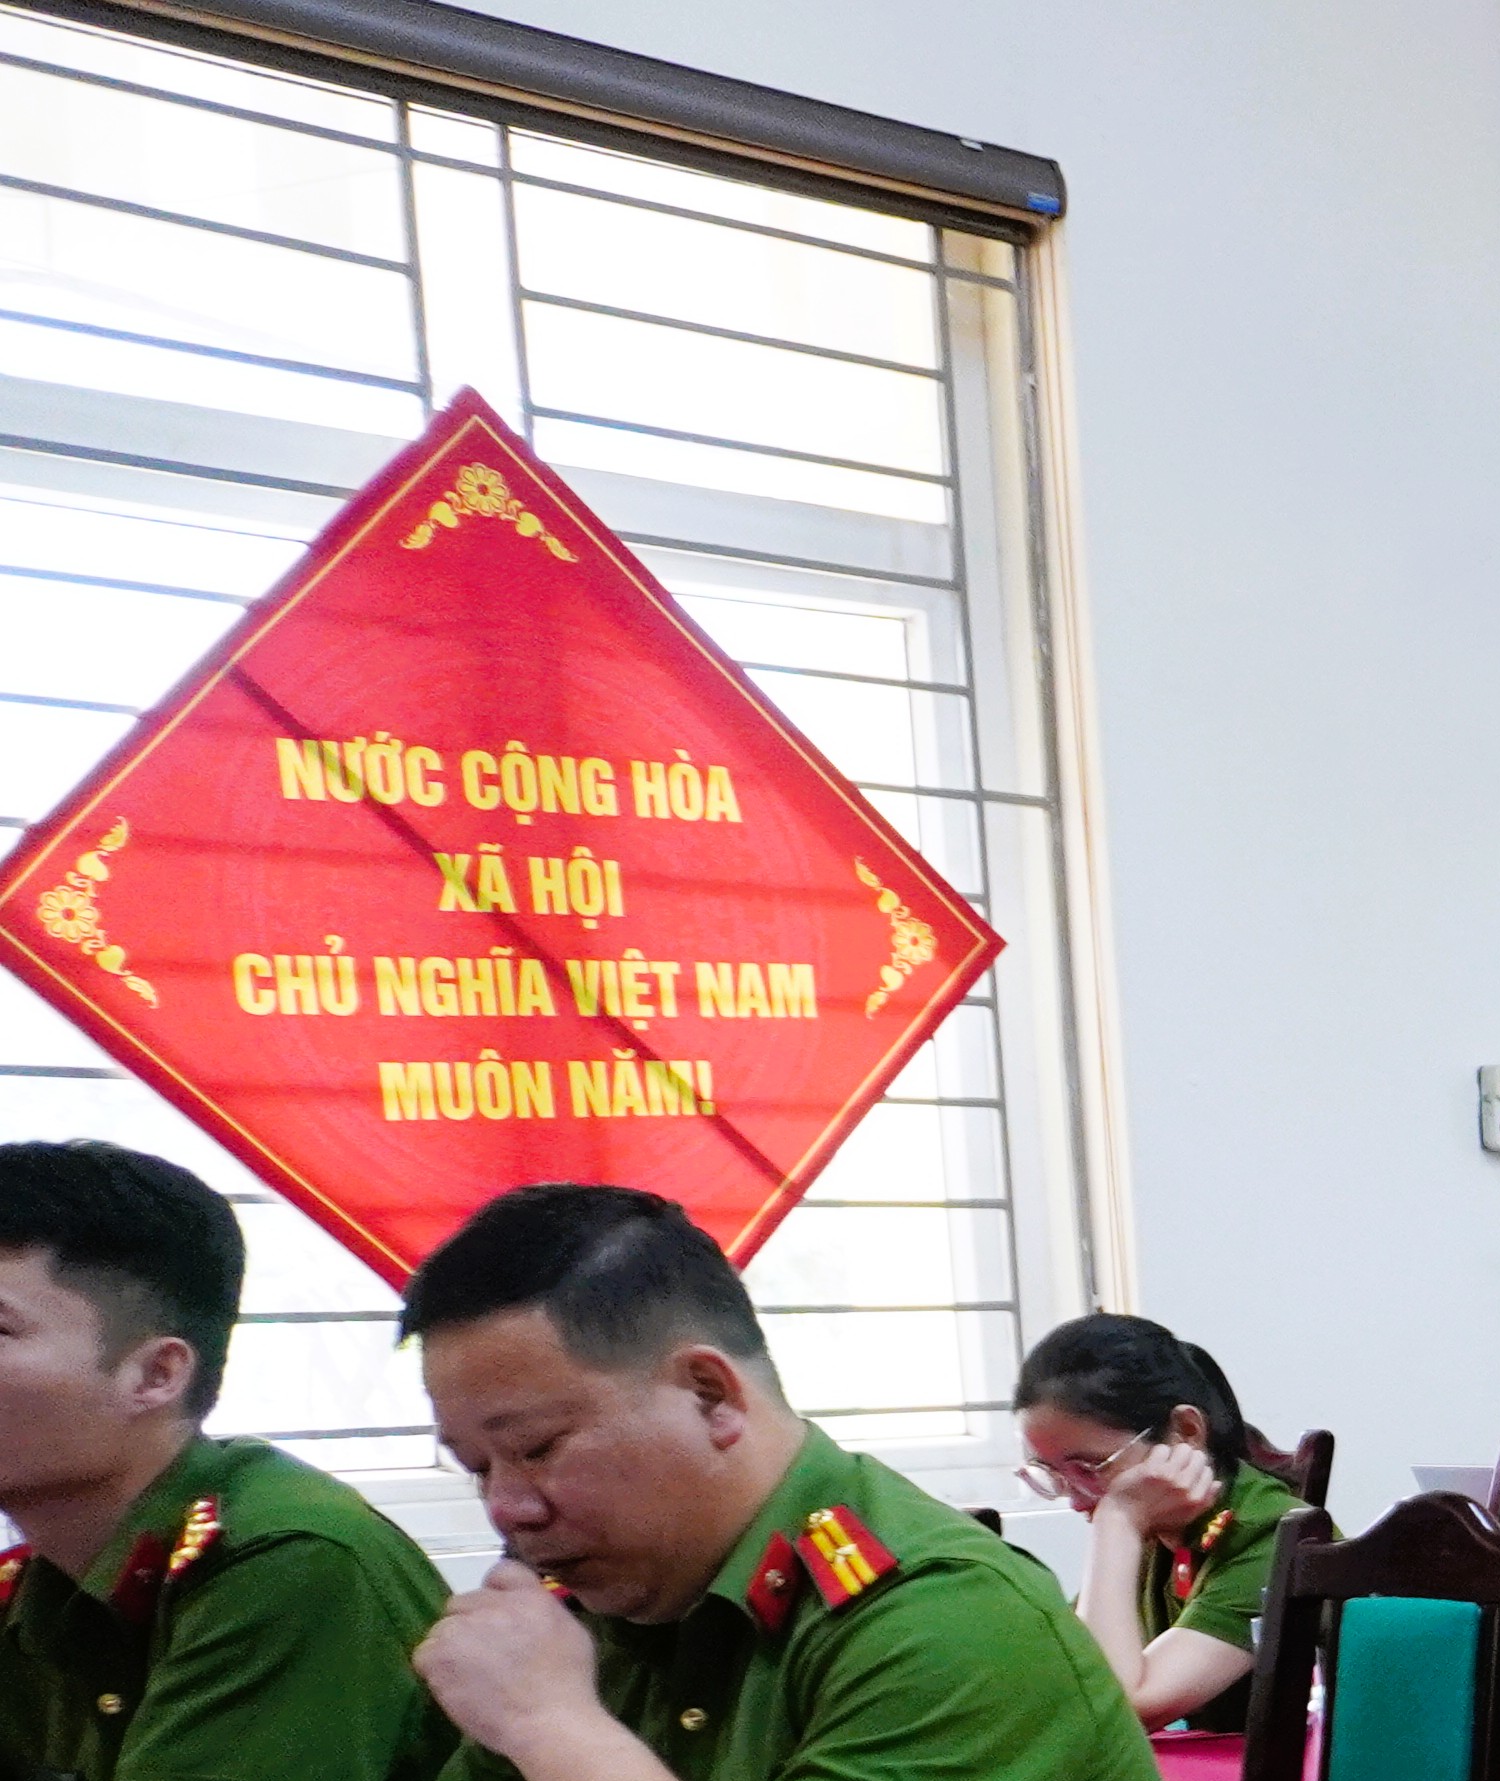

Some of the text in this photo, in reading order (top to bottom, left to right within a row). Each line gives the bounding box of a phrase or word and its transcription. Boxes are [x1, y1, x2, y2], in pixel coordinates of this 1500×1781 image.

[275, 731, 744, 826] NƯỚC CỘNG HÒA
[433, 843, 625, 930] XÃ HỘI
[233, 934, 818, 1031] CHỦ NGHĨA VIỆT NAM
[378, 1048, 716, 1121] MUÔN NĂM!
